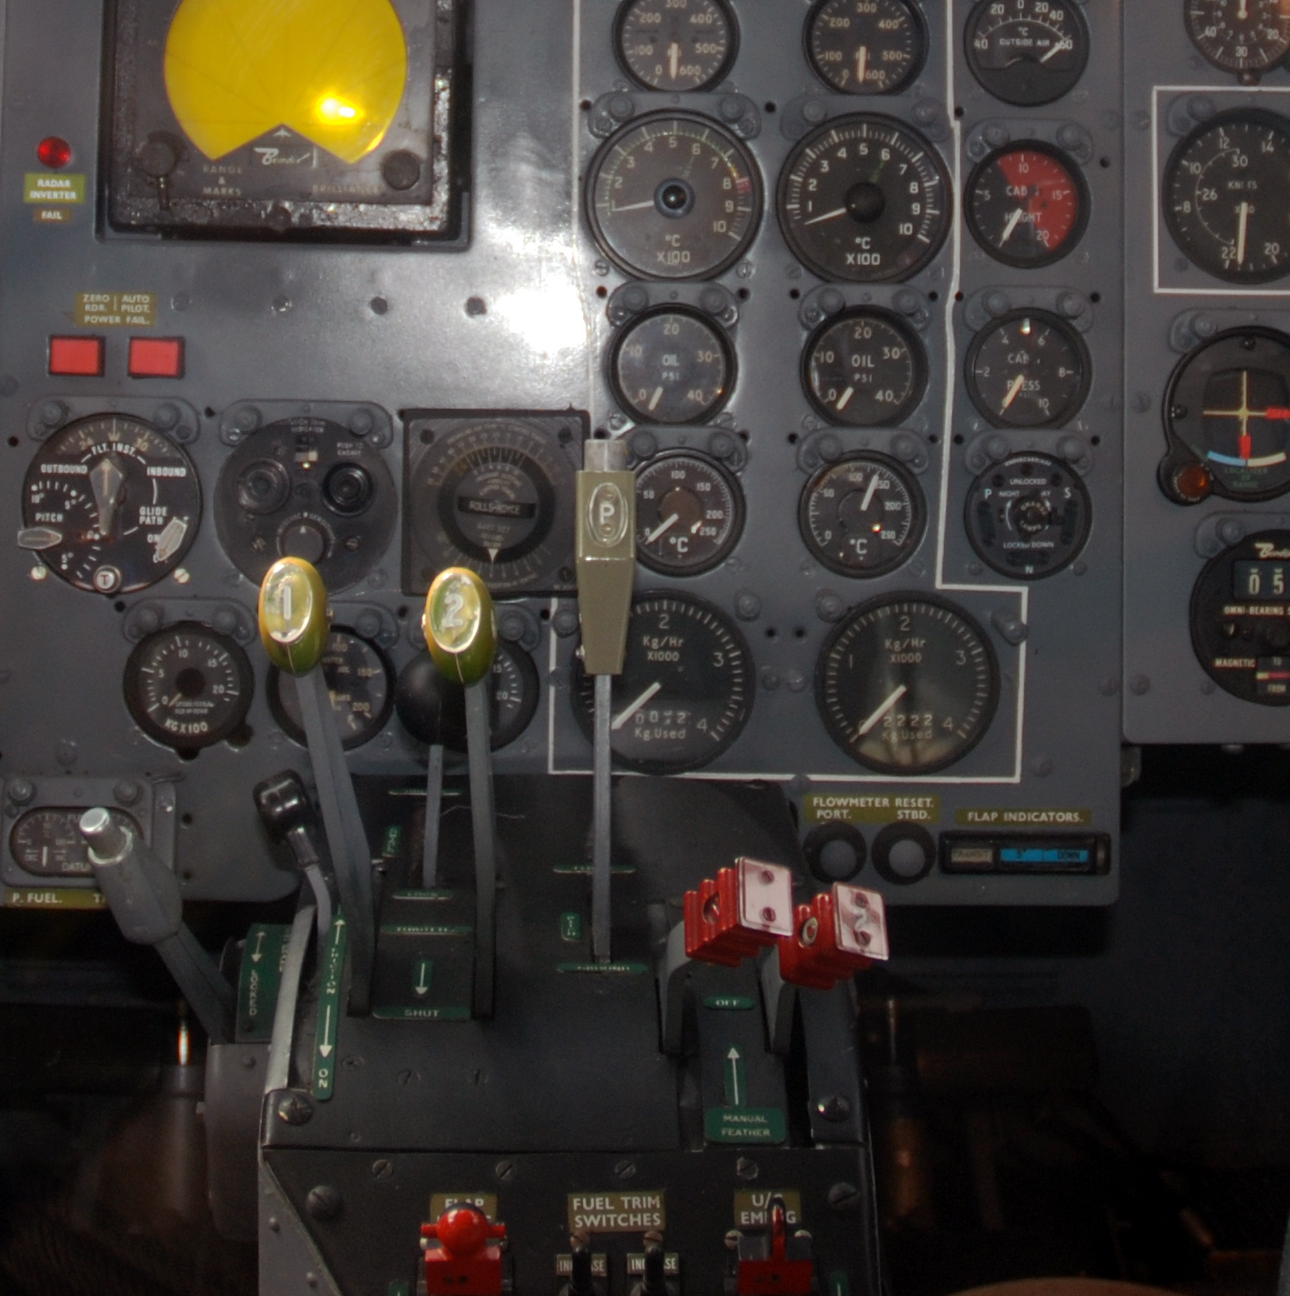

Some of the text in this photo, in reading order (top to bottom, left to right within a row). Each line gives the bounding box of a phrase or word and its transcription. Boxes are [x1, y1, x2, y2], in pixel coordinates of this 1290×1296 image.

[857, 3, 877, 12] 300
[990, 4, 1004, 14] 20
[1035, 2, 1049, 13] 20
[639, 13, 661, 23] 200
[690, 14, 713, 24] 400
[830, 18, 850, 27] 200
[878, 19, 899, 28] 400
[695, 43, 717, 53] 500
[825, 51, 842, 60] 100
[883, 51, 903, 60] 500
[680, 66, 702, 75] 600
[1261, 142, 1274, 153] 14
[1232, 156, 1248, 167] 30
[203, 165, 242, 174] RANGE
[1189, 163, 1201, 174] 10
[37, 179, 71, 187] RADAR
[30, 191, 76, 199] INVERTER
[202, 187, 242, 196] MARKS
[1006, 186, 1027, 196] CAB
[1202, 189, 1217, 200] 26
[1264, 242, 1280, 254] 20
[83, 294, 110, 303] ZERO
[121, 295, 150, 303] AUTO
[121, 305, 150, 313] PILOT.
[84, 315, 150, 324] POWER FAIL.
[854, 327, 872, 339] 20
[819, 351, 834, 363] 10
[882, 347, 900, 359] 30
[662, 355, 679, 366] OIL
[851, 355, 875, 368] OIL
[1007, 354, 1029, 363] CAB
[662, 372, 679, 380] PSI
[854, 374, 872, 382] PSI
[875, 390, 893, 402] 40
[41, 465, 88, 474] OUTBOUND
[147, 468, 186, 477] INBOUND
[139, 507, 167, 516] GLIDE
[599, 502, 615, 524] P
[35, 513, 63, 522] PITCH
[139, 516, 164, 525] PATH
[283, 584, 292, 621] 1
[441, 594, 463, 628] 2
[1223, 605, 1284, 615] OMNI-BEARING
[659, 614, 669, 629] 2
[900, 616, 910, 631] 2
[643, 636, 684, 648] Kg/Hr
[884, 639, 926, 651] Kg/Hr
[714, 652, 724, 667] 3
[956, 650, 966, 666] 3
[1214, 658, 1256, 667] MAGNETIC
[943, 718, 954, 731] 4
[901, 730, 932, 739] Used
[813, 797, 934, 808] FLOWMETER RESET.
[816, 810, 852, 820] PORT.
[897, 809, 932, 820] STBD.
[967, 812, 1084, 822] FLAP INDICATORS.
[28, 893, 62, 903] FUEL.
[404, 1008, 440, 1018] SHUT
[722, 1114, 768, 1123] MANUAL
[721, 1128, 771, 1137] FEATHER
[573, 1197, 660, 1211] FUEL TRIM
[574, 1213, 661, 1228] SWITCHES
